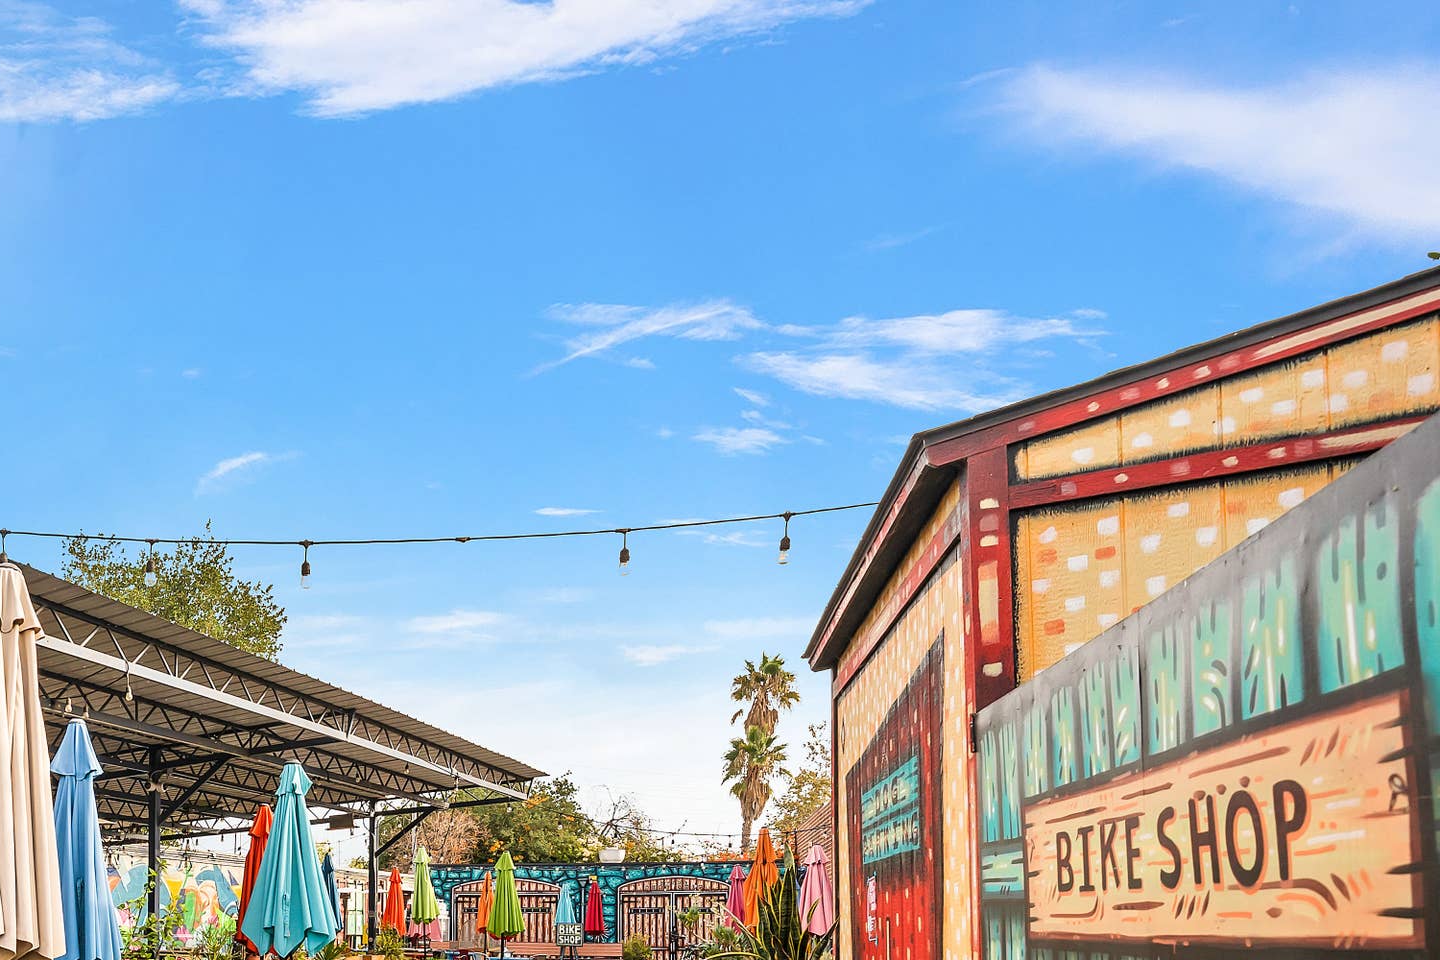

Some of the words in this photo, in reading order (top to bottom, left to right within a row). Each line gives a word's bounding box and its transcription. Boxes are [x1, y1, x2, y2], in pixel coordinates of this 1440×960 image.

[874, 776, 898, 813] DOG
[863, 812, 918, 862] PARKING
[1055, 816, 1143, 893] BIKE
[1156, 779, 1308, 889] SHOP
[559, 925, 581, 935] BIKE
[559, 935, 581, 944] SHOP
